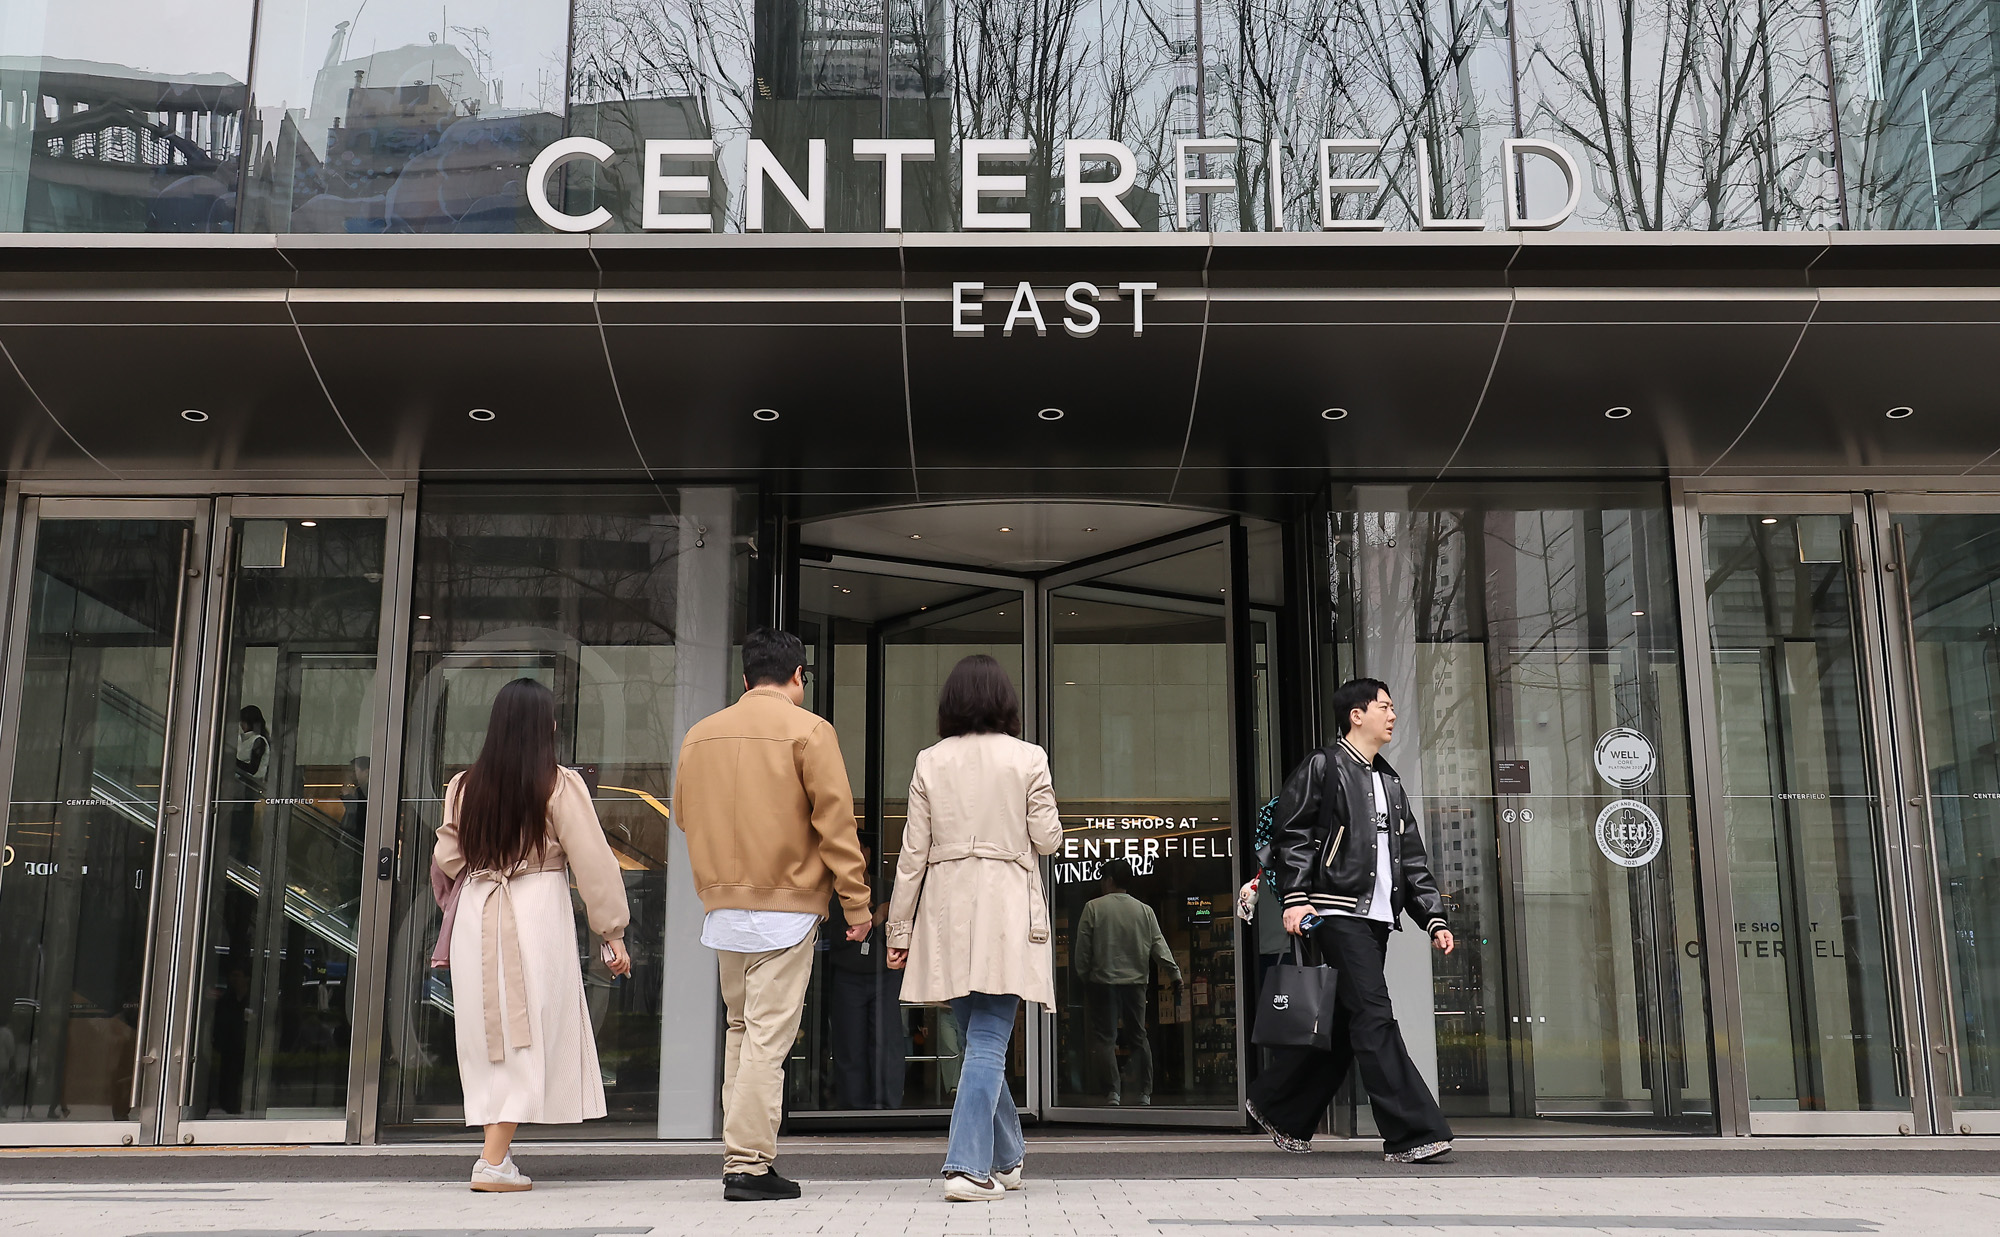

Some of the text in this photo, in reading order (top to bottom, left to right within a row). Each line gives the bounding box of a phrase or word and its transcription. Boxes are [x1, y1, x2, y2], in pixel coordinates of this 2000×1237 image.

[526, 137, 1582, 232] CENTERFIELD
[952, 281, 1158, 338] EAST
[1610, 750, 1640, 759] WELL
[1602, 803, 1619, 818] ENERGY
[1085, 817, 1199, 830] THE SHOPS AT
[1610, 823, 1647, 841] LEED
[1054, 837, 1233, 859] ENTERFIEL
[1751, 922, 1780, 933] SHO
[1273, 994, 1289, 1005] aws
